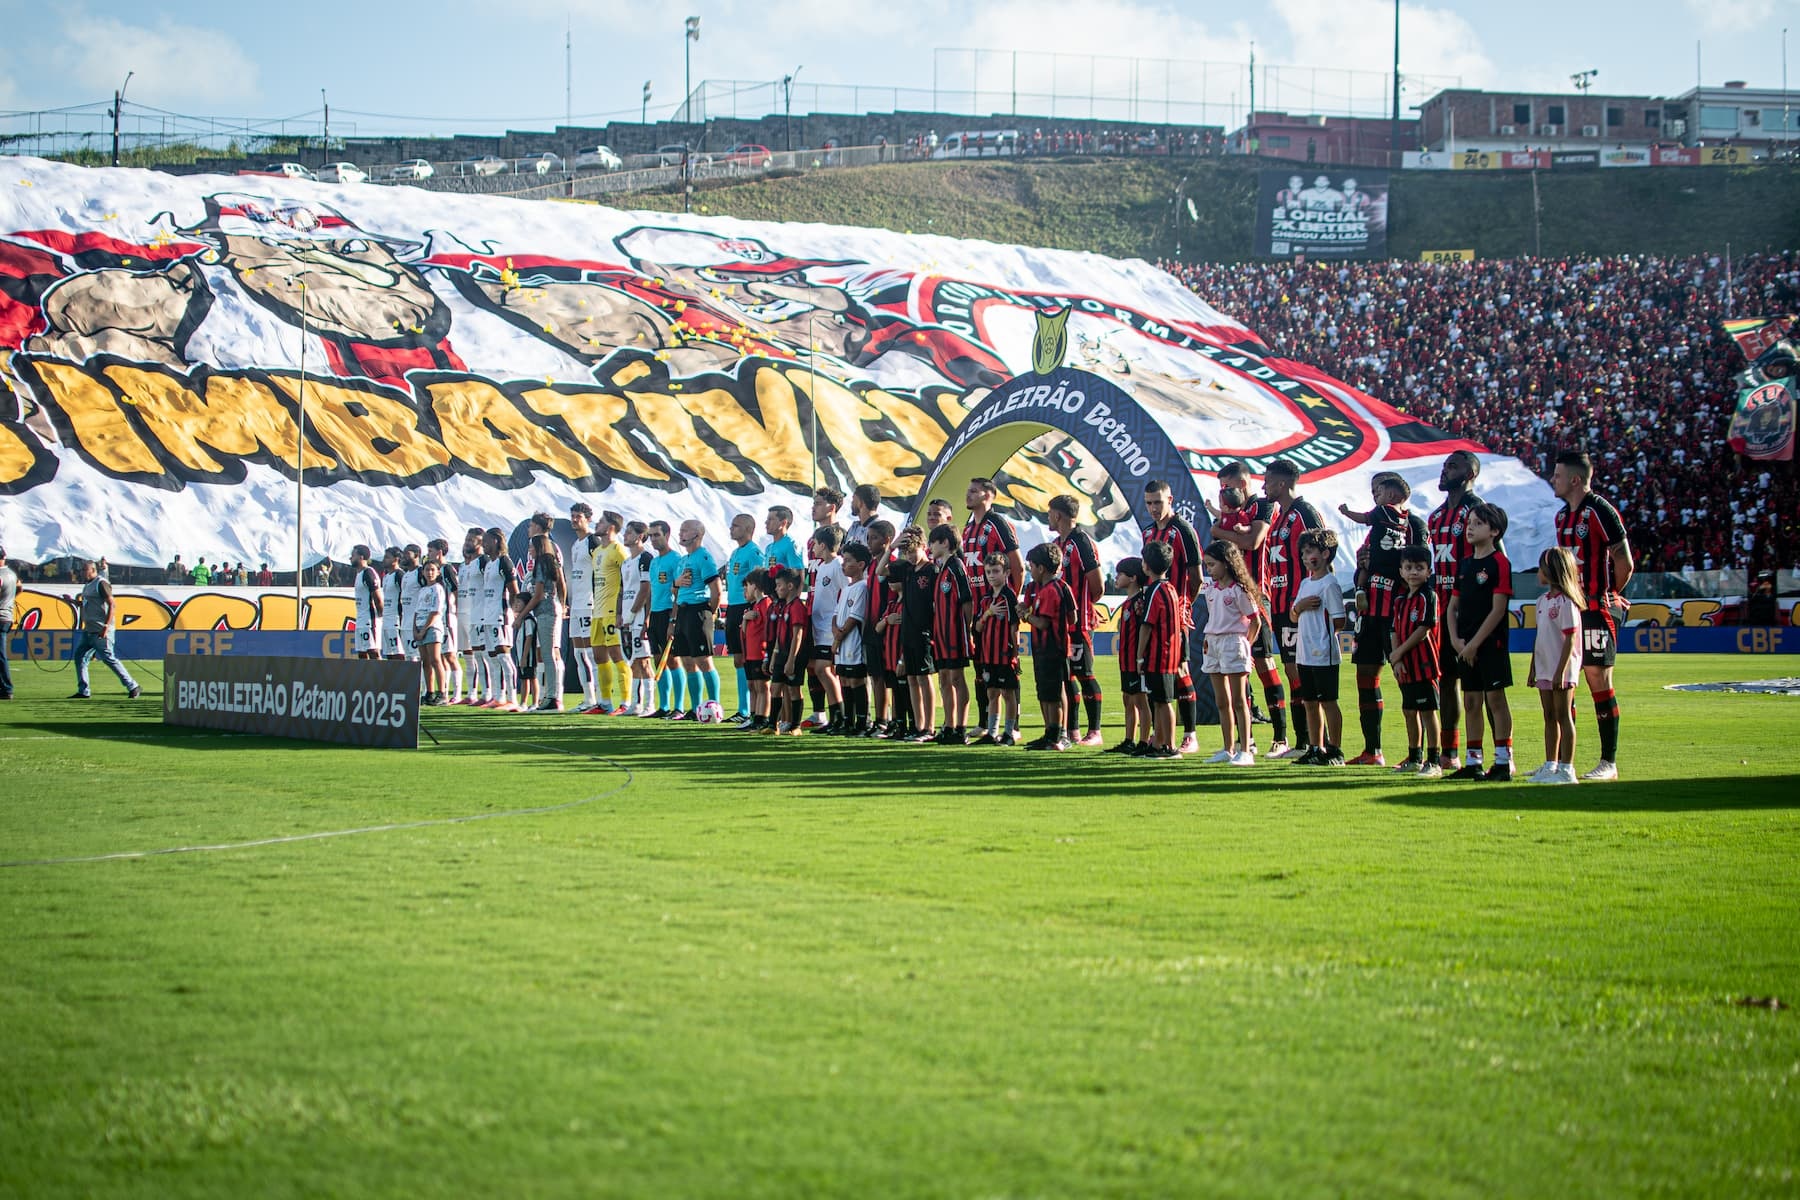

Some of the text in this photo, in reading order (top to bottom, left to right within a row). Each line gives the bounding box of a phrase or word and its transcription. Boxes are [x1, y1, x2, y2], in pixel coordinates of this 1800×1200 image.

[1273, 206, 1369, 222] É OFICIAL
[1272, 230, 1318, 239] CHEGOU
[1320, 232, 1337, 240] AO
[1433, 252, 1461, 262] BAR
[926, 380, 1151, 492] BRASILEIRÃO Betano
[964, 551, 983, 567] 7K
[1269, 545, 1288, 562] K
[1435, 544, 1456, 562] 7K
[579, 616, 591, 628] 13
[493, 627, 499, 638] 9
[1635, 628, 1679, 652] CBF
[1737, 628, 1783, 653] CBF
[7, 632, 73, 660] CBF
[167, 632, 234, 655] CBF
[634, 637, 642, 648] 8
[178, 674, 406, 728] BRASILEIRÃO Betano 2025
